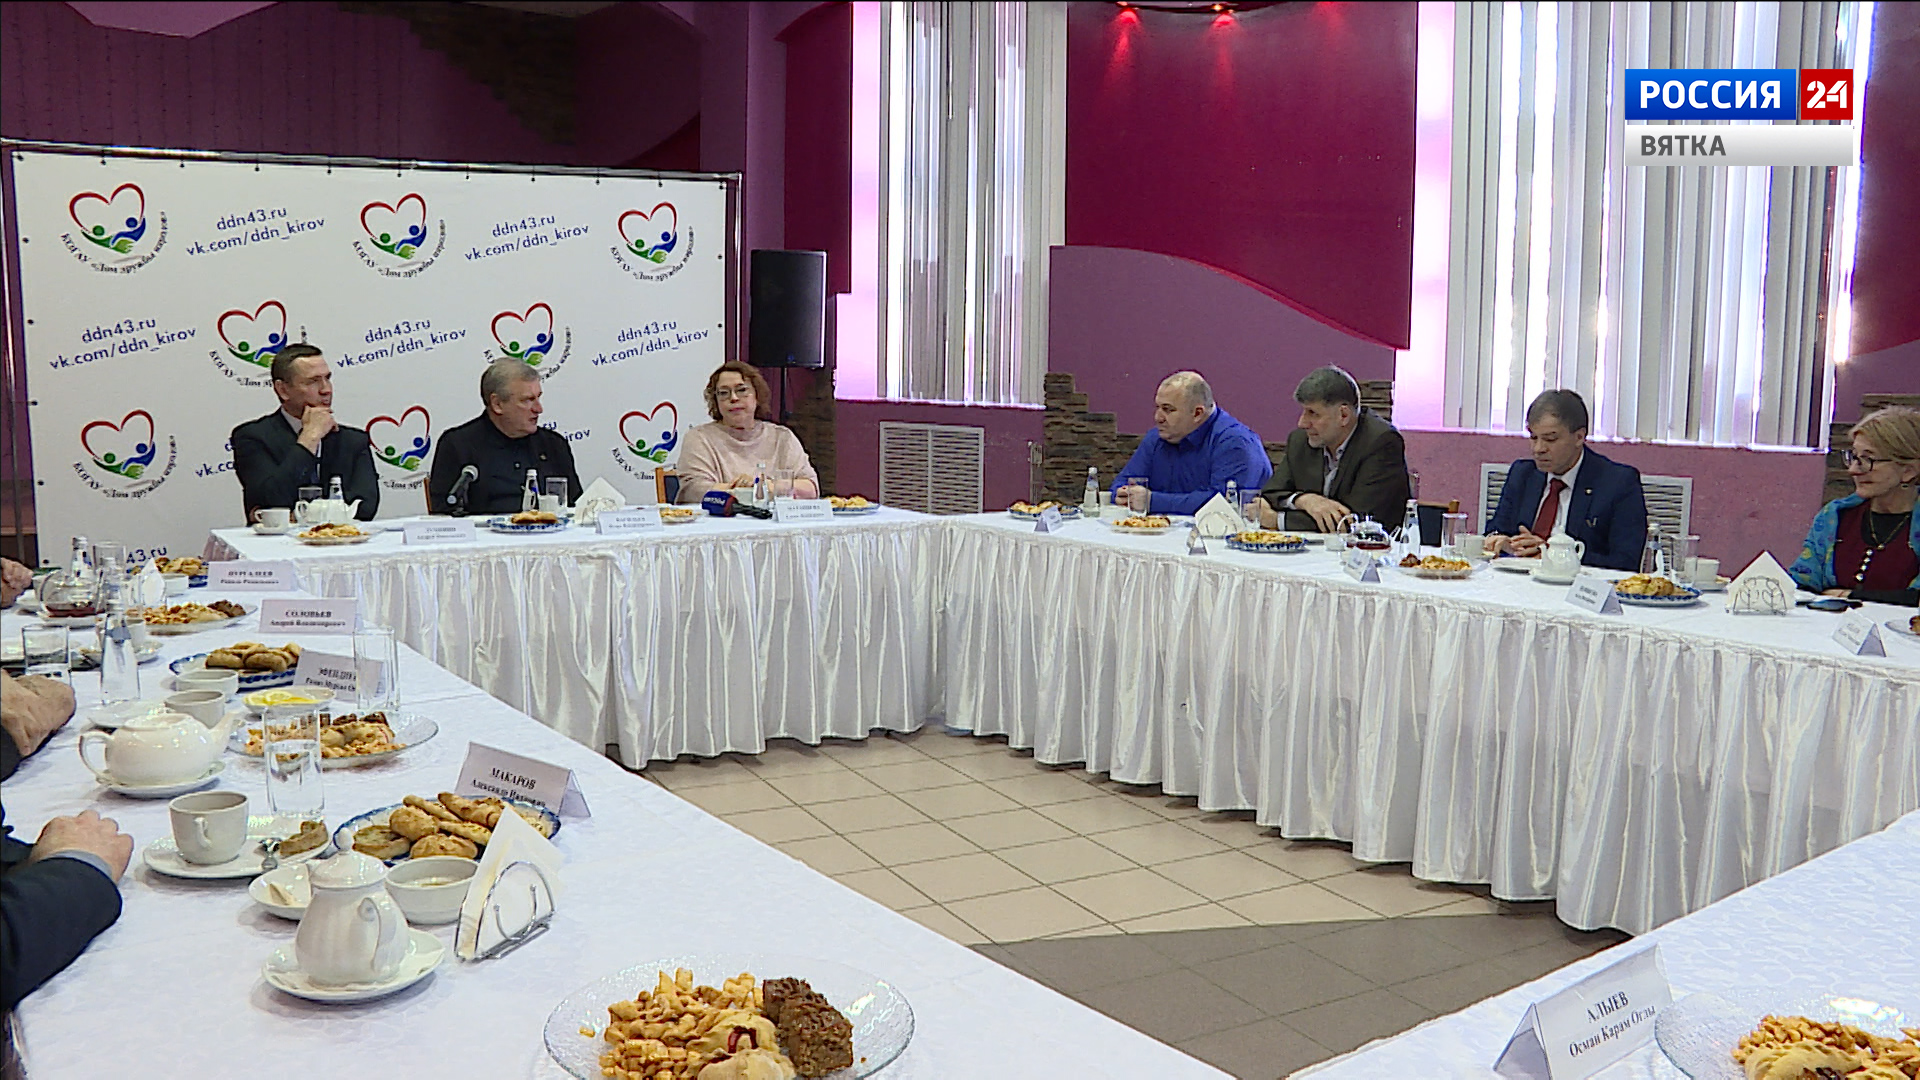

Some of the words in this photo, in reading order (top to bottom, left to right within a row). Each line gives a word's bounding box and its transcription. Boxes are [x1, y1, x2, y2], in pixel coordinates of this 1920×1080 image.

[216, 207, 287, 230] ddn43.ru
[492, 215, 555, 237] ddn43.ru
[186, 218, 325, 255] vk.com/ddn_kirov
[464, 225, 589, 260] vk.com/ddn_kirov
[82, 318, 156, 344] ddn43.ru
[365, 320, 431, 343] ddn43.ru
[617, 321, 677, 343] ddn43.ru
[49, 328, 196, 369] vk.com/ddn_kirov
[337, 329, 466, 367] vk.com/ddn_kirov
[592, 330, 708, 365] vk.com/ddn_kirov
[126, 546, 167, 563] 43.ru
[491, 767, 536, 790] МАКАРОВ
[1569, 1033, 1601, 1057] Осман
[1601, 1020, 1631, 1042] Карам
[1631, 1006, 1656, 1025] Оглы
